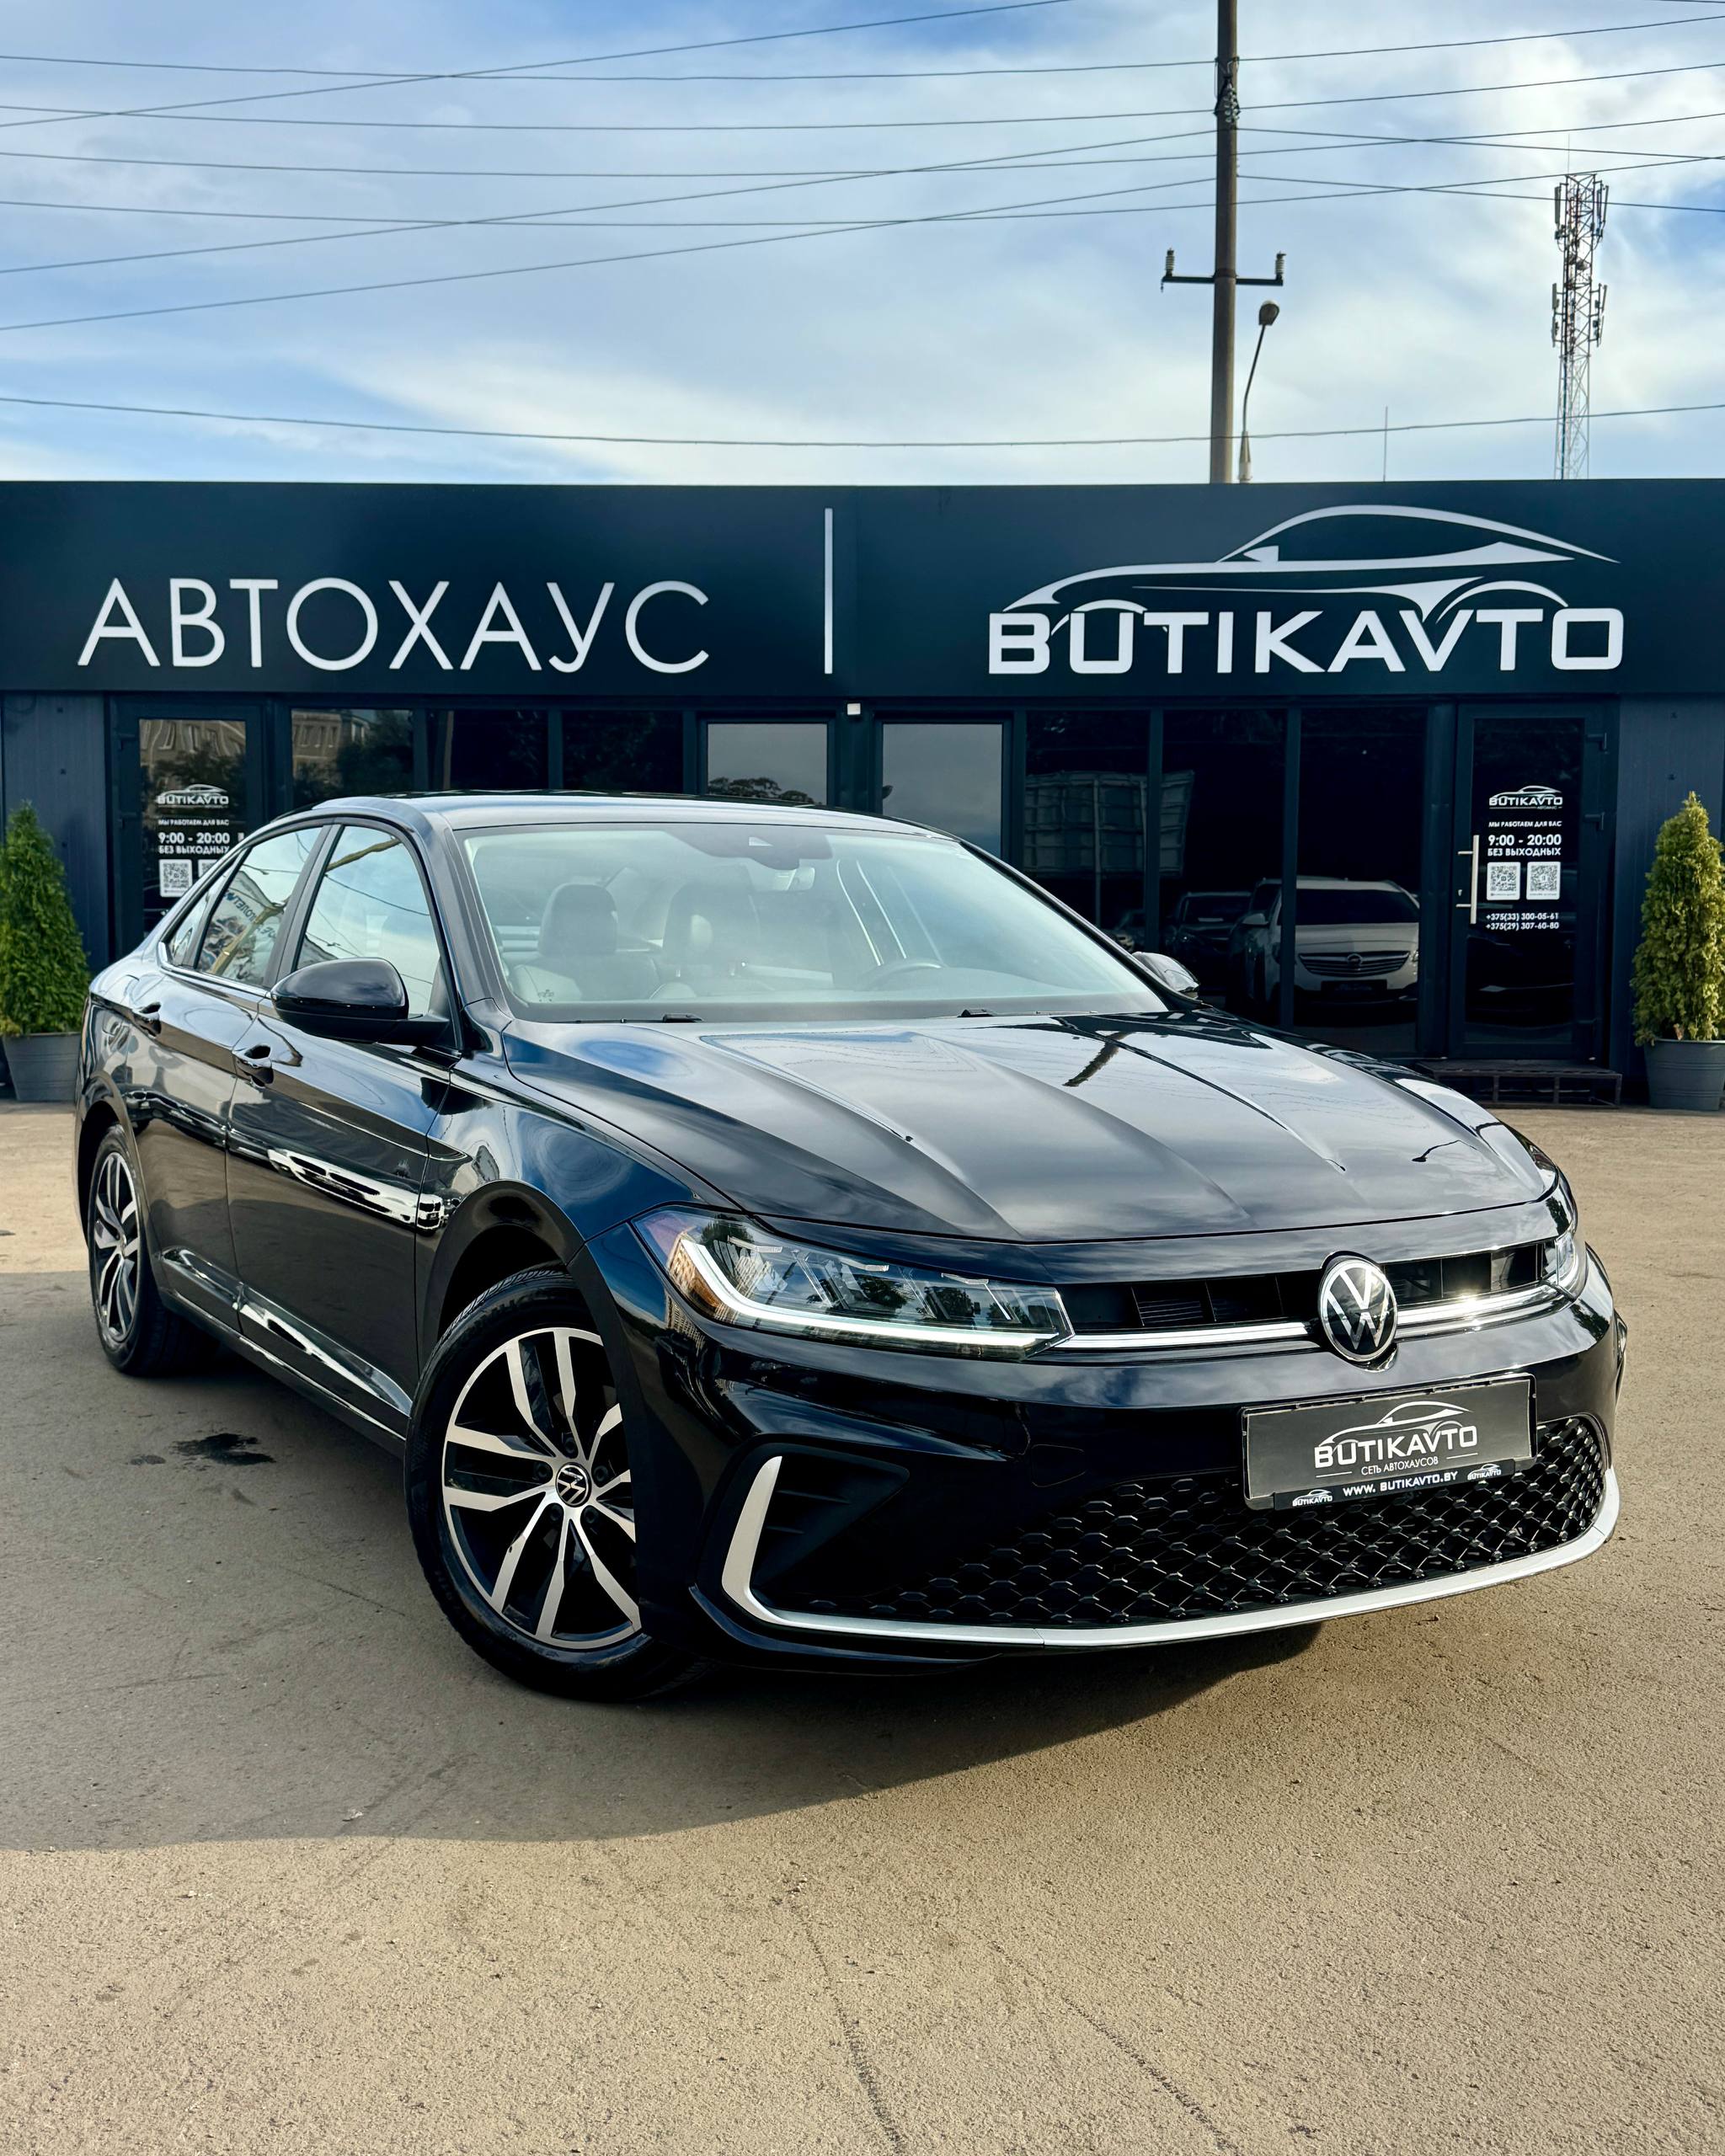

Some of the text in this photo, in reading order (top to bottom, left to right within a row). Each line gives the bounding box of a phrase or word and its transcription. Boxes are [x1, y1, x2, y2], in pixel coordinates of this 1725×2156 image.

[77, 577, 709, 674] АВТОХАУС
[989, 607, 1624, 675] BUTIKAVTO
[158, 795, 229, 805] BUTIKAVTO
[1488, 797, 1563, 806] BUTIKAVTO
[158, 832, 184, 844] 9:00
[196, 832, 230, 844] 20:00
[1487, 835, 1515, 846] 9:00
[1526, 834, 1562, 846] 20:00
[158, 845, 174, 854] БЕЗ
[1487, 847, 1562, 857] БЕЗ ВЫХОДНЫХ
[1486, 912, 1559, 921] +375(33) 300-05-61
[1486, 922, 1519, 931] +375(29)
[1315, 1426, 1477, 1468] BUTIKAVTO
[1361, 1456, 1439, 1476] СЕТЬ АВТОХАУСОВ
[1467, 1469, 1502, 1480] BUTIKAVTO
[1380, 1470, 1458, 1492] BUTIKAVTO.BY
[1292, 1494, 1333, 1507] BUTIKAVTO
